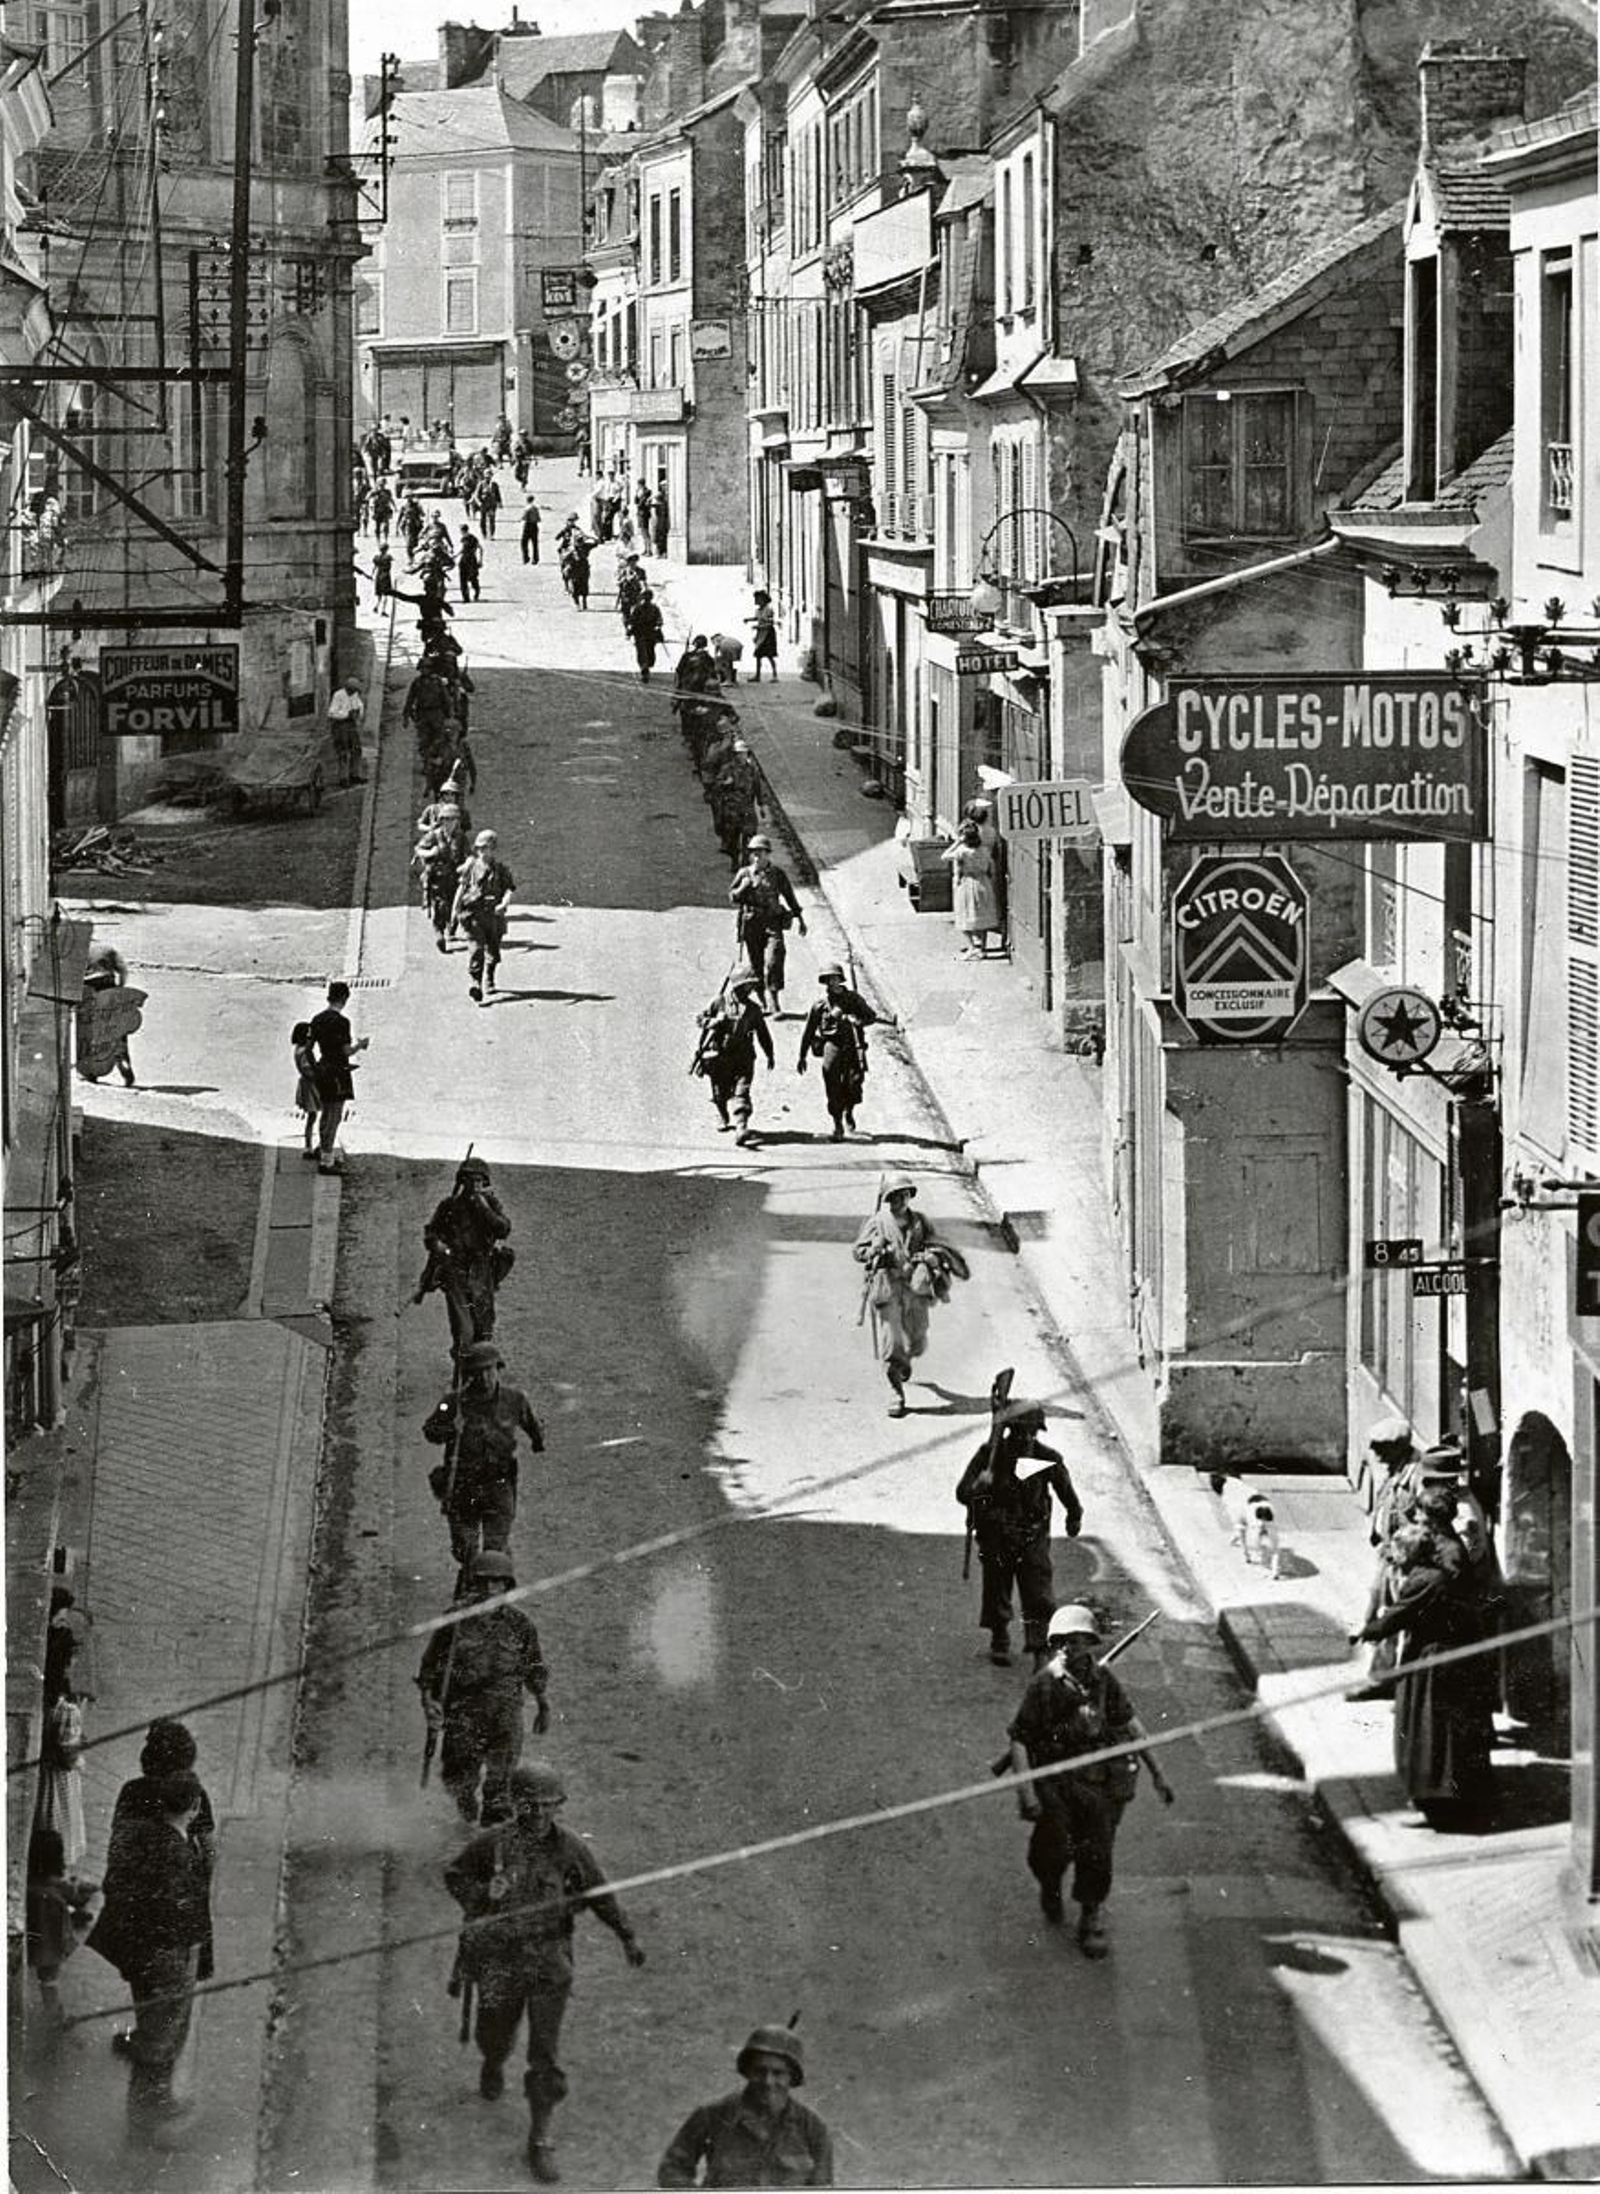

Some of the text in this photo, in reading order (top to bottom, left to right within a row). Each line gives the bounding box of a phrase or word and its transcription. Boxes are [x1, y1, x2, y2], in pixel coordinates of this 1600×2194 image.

[105, 654, 169, 686] COIFFEUR
[184, 653, 233, 681] DAMES
[959, 653, 1017, 672] HOTEL
[125, 682, 213, 698] PARFUMS
[1177, 684, 1464, 753] CYCLES-MOTOS
[1175, 757, 1474, 829] Vente-Réparation
[1007, 788, 1090, 830] HÔTEL
[1189, 987, 1291, 1001] CONCESSIONNAIRE
[1214, 999, 1265, 1012] EXCLUSIF
[1374, 1242, 1389, 1263] 8
[1414, 1272, 1469, 1294] ALCOOL
